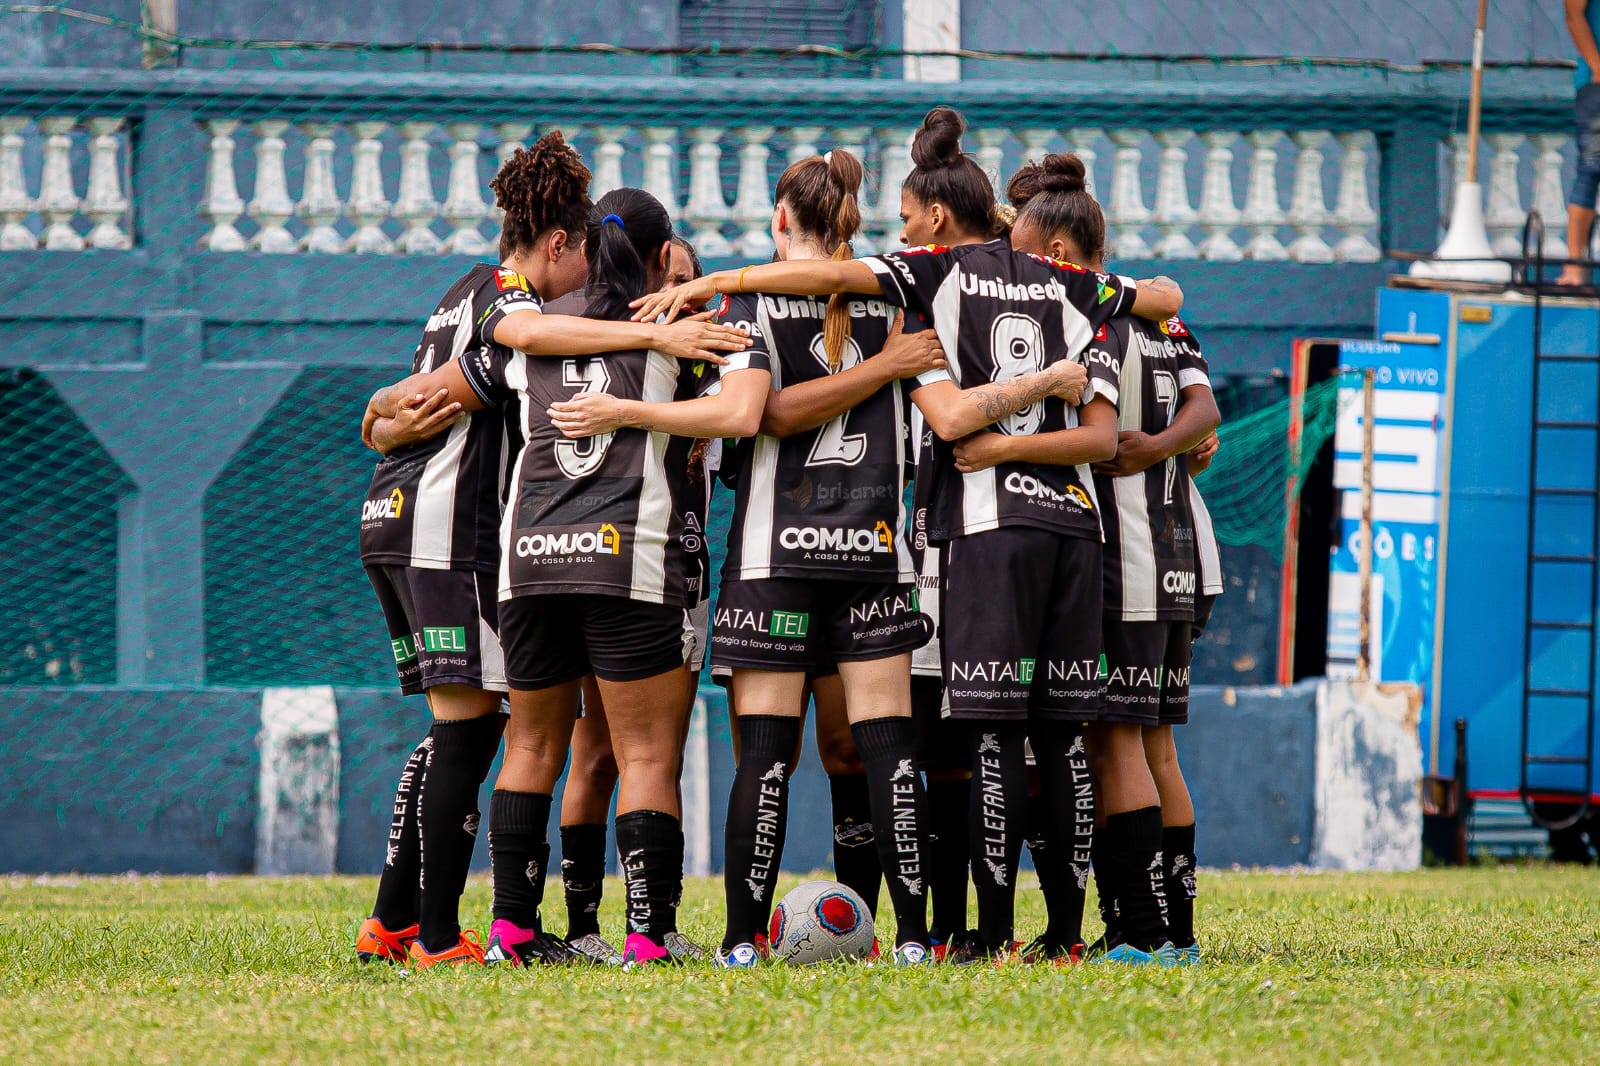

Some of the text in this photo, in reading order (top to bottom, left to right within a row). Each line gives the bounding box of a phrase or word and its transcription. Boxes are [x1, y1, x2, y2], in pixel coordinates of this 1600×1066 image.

[960, 272, 1062, 301] Unimed
[554, 357, 611, 480] 3
[805, 332, 867, 467] 2
[990, 312, 1045, 436] 8
[1153, 370, 1177, 505] 7
[532, 558, 540, 566] A
[541, 557, 564, 565] casa
[814, 552, 838, 560] casa
[842, 552, 848, 560] é
[435, 656, 447, 665] da
[449, 657, 467, 666] vida
[750, 639, 773, 649] favor
[775, 643, 787, 651] da
[789, 643, 805, 652] vida
[852, 624, 898, 640] Tecnologia
[951, 689, 1000, 700] Tecnologia
[389, 752, 423, 840] ELEFANTE
[750, 783, 780, 880] ELEFANTE
[893, 783, 920, 874] ELEFANTE
[981, 755, 1006, 857] ELEFANTE
[1069, 759, 1094, 862] ELEFANTE
